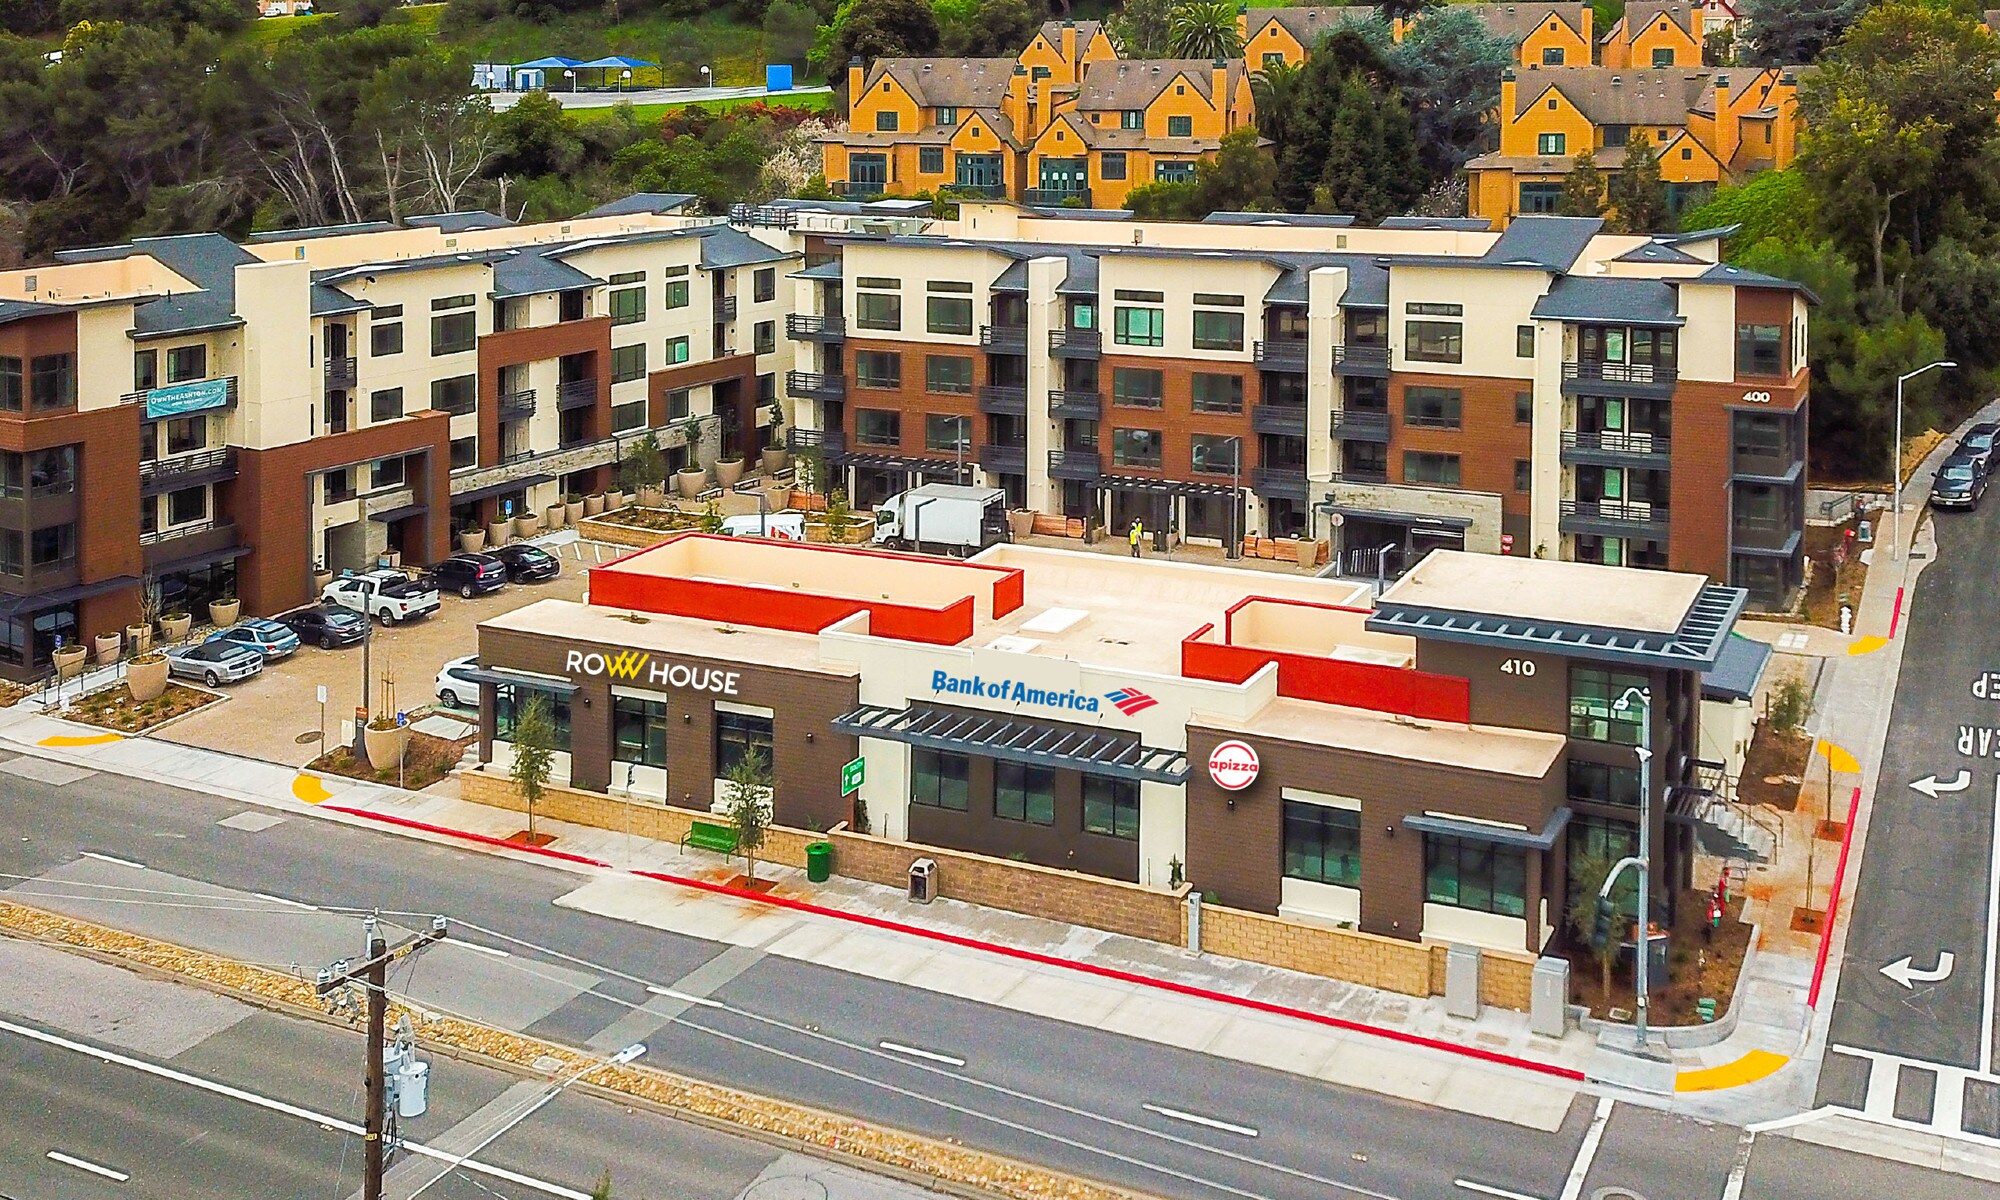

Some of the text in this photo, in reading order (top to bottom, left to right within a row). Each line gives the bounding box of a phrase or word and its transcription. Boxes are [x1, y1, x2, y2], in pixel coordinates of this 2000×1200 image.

[1742, 391, 1771, 403] 400
[1500, 658, 1536, 677] 410
[649, 661, 741, 695] HOUSE
[931, 670, 1099, 713] Bank of America
[1209, 758, 1259, 773] apizza
